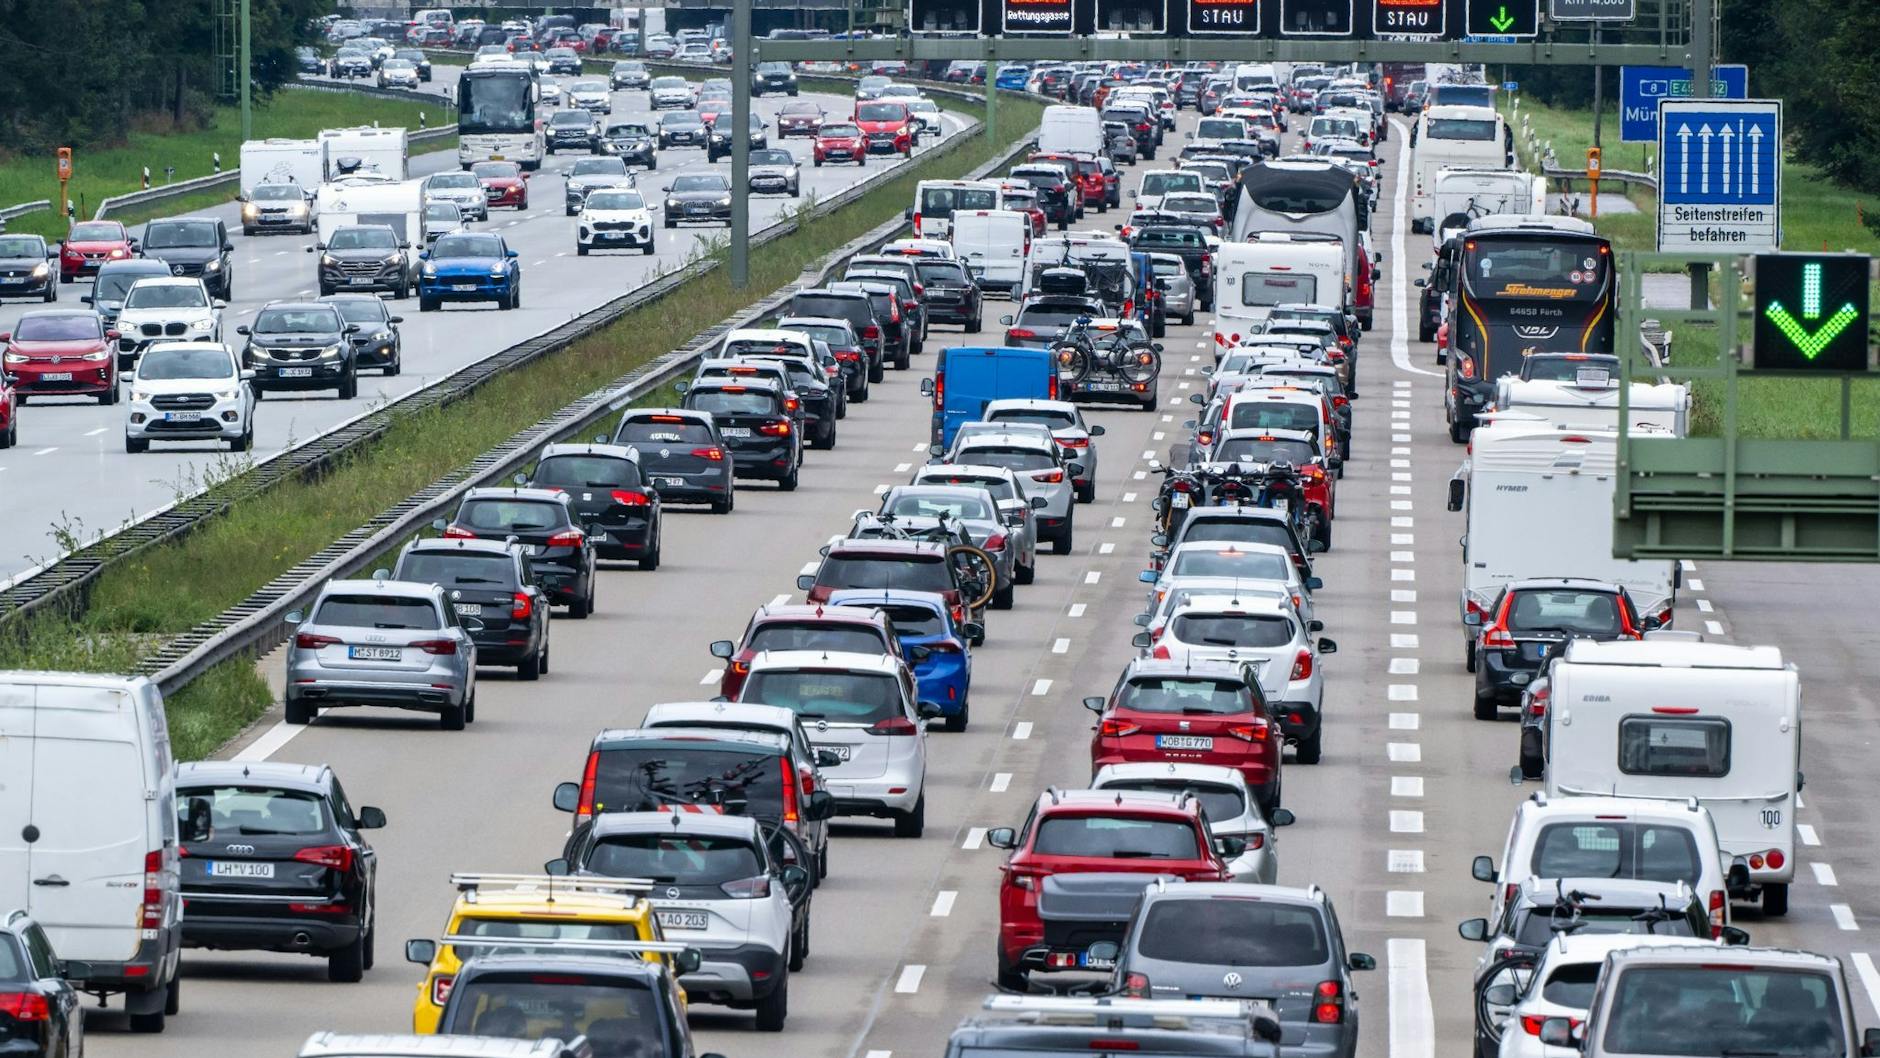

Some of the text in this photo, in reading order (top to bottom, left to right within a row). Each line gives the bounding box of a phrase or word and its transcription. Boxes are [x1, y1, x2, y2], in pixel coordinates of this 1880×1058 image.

[1007, 10, 1069, 23] Rettungsgasse
[1202, 9, 1243, 24] STAU
[1387, 11, 1428, 26] STAU
[1650, 84, 1658, 94] 8
[1672, 83, 1691, 94] E4
[1626, 107, 1658, 122] Mün
[1675, 206, 1763, 223] Seitenstreifen
[1690, 227, 1746, 243] befahren
[1496, 283, 1577, 298] Strohmenger
[1540, 308, 1563, 317] Fürth
[1496, 484, 1528, 492] HYMER
[354, 647, 400, 659] M ST 8912
[1162, 737, 1180, 747] WOB
[1194, 738, 1211, 748] 770
[1762, 810, 1780, 825] 100
[216, 864, 270, 877] LH V 100
[667, 914, 707, 927] AO 203
